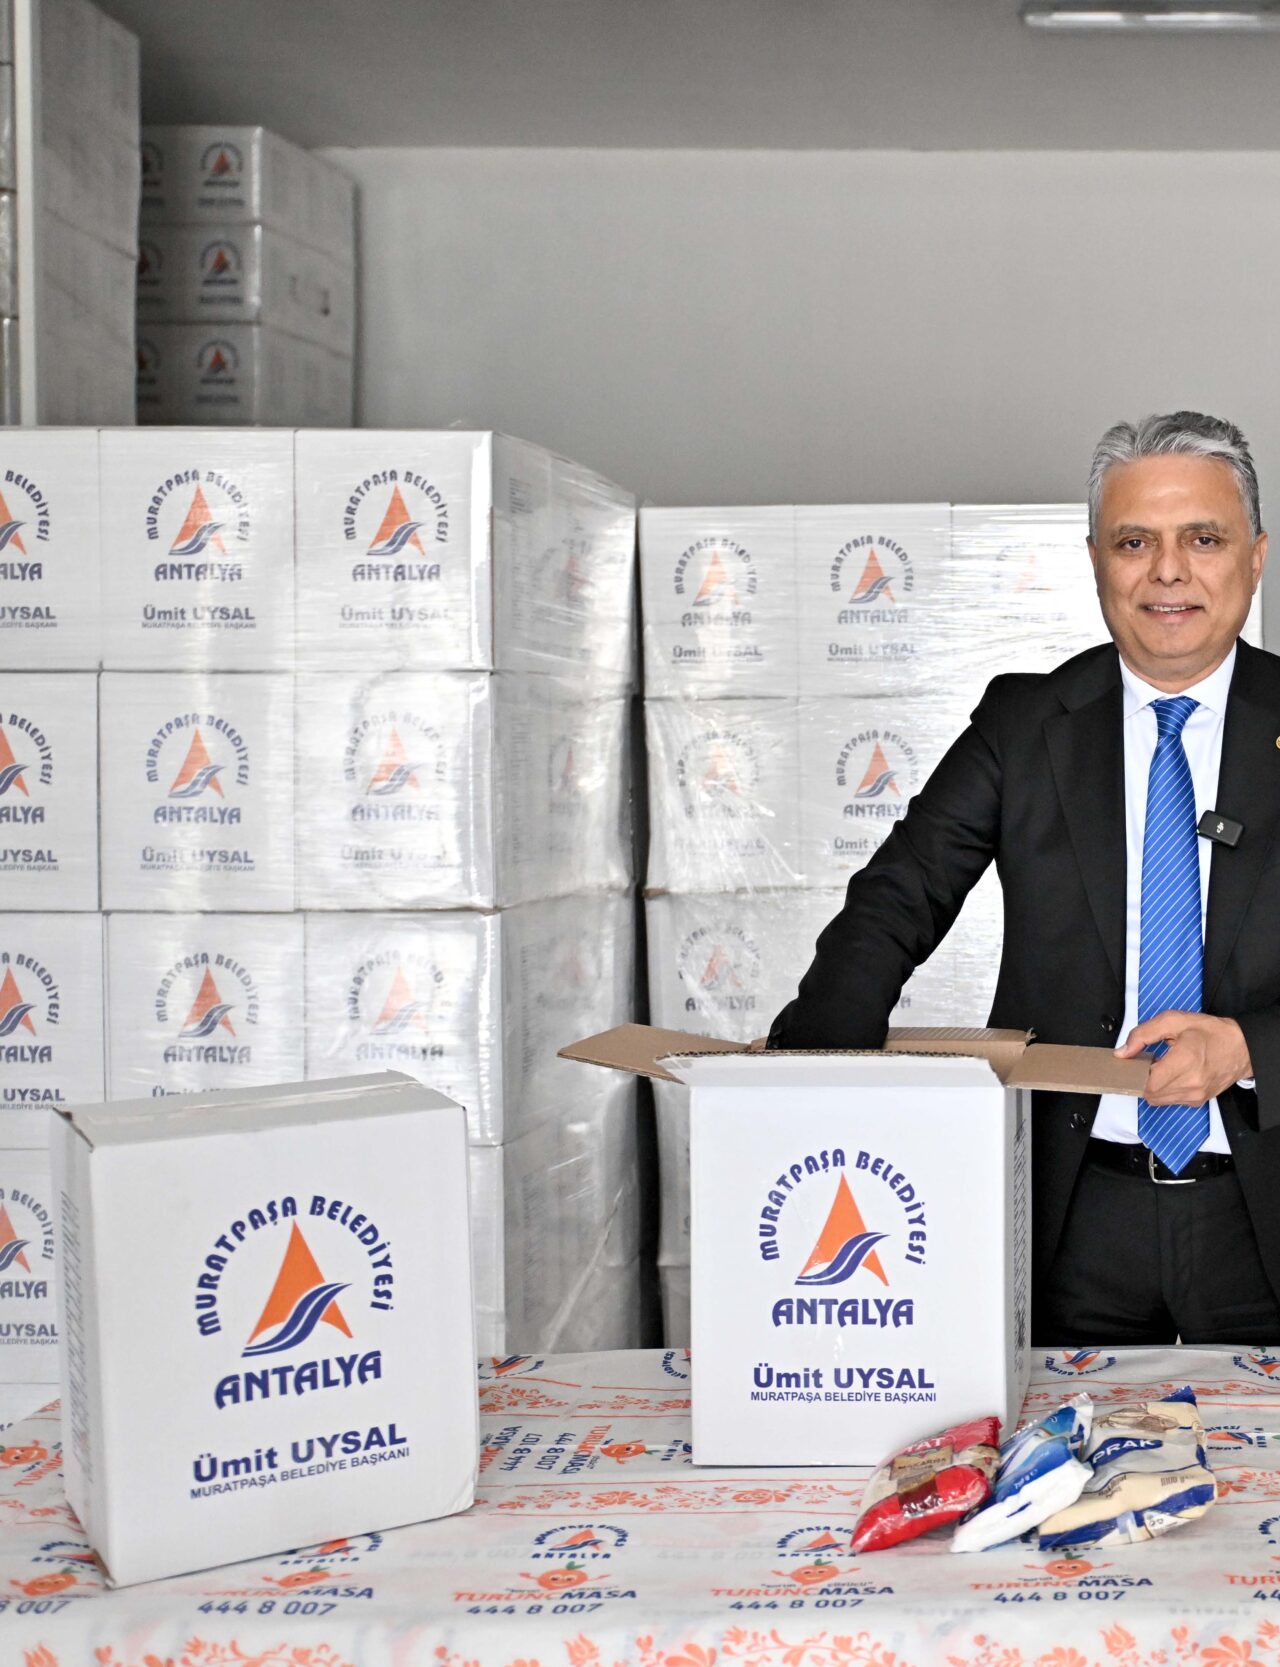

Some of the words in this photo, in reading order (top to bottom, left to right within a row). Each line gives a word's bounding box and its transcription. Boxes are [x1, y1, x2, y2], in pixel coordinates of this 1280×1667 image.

[5, 470, 50, 541] BELEDİYESİ
[155, 563, 242, 582] ANTALYA
[352, 564, 441, 582] ANTALYA
[9, 714, 53, 786] BELEDİYESİ
[154, 807, 241, 824] ANTALYA
[4, 1089, 65, 1102] UYSAL
[759, 1149, 845, 1261] MURATPAŞA
[856, 1151, 926, 1265] BELEDİYESİ
[195, 1197, 297, 1336] MURATPAŞA
[309, 1195, 394, 1312] BELEDİYESİ
[772, 1298, 914, 1328] ANTALYA
[214, 1350, 381, 1410] ANTALYA
[753, 1363, 823, 1388] Ümit
[834, 1368, 934, 1389] UYSAL
[751, 1391, 821, 1403] MURATPAŞA
[824, 1390, 881, 1402] BELEDİYE
[884, 1392, 936, 1404] BAŞKANI
[193, 1447, 278, 1482] Ümit
[291, 1424, 407, 1463] UYSAL
[190, 1473, 277, 1499] MURATPAŞA
[280, 1459, 348, 1482] BELEDİYE
[351, 1448, 410, 1470] BAŞKANI
[729, 1600, 776, 1611] 444
[788, 1600, 802, 1610] 8
[814, 1599, 865, 1609] 007
[994, 1592, 1041, 1602] 444
[1053, 1591, 1067, 1602] 8
[1078, 1590, 1126, 1601] 007
[16, 1600, 71, 1615] 007
[198, 1601, 248, 1615] 444
[258, 1601, 275, 1615] 8
[284, 1601, 337, 1615] 007
[466, 1605, 515, 1615] 444
[527, 1604, 541, 1614] 8
[552, 1604, 603, 1614] 007
